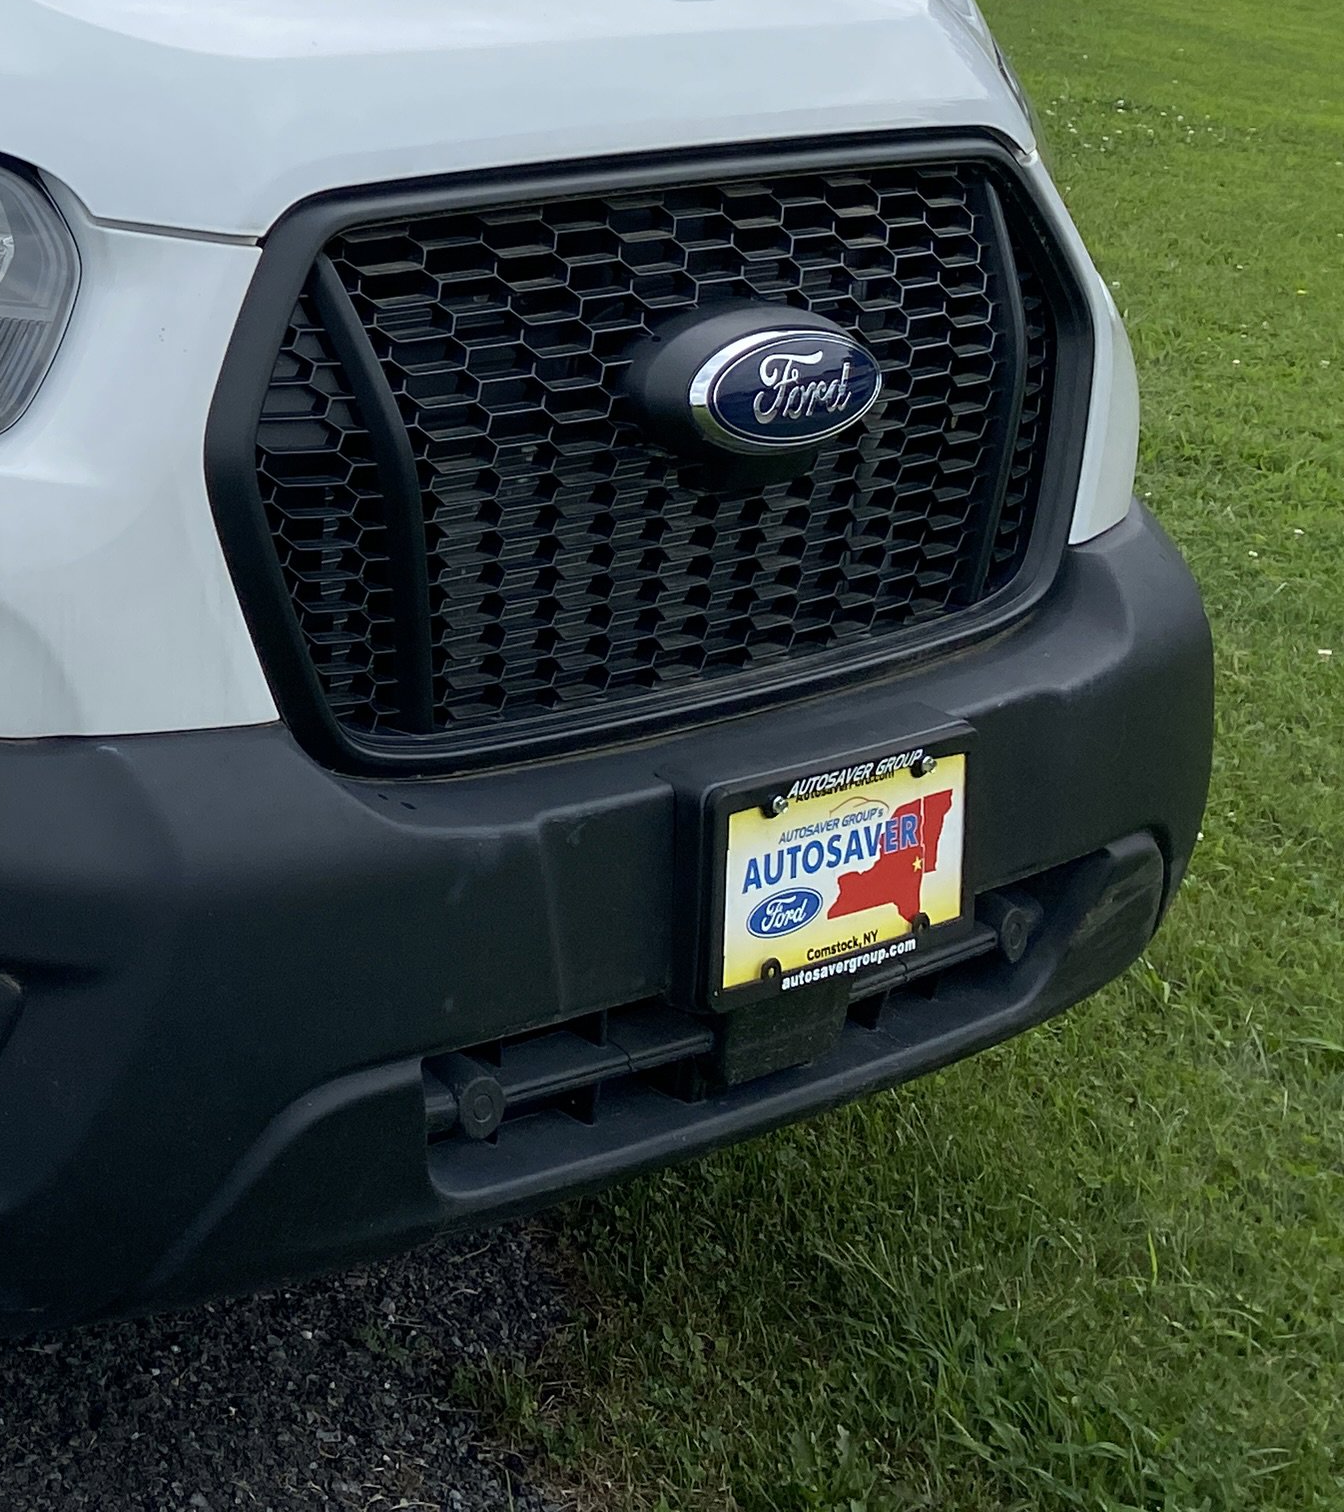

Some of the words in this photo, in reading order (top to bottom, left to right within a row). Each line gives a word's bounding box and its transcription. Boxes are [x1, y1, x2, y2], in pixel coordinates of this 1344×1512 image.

[753, 350, 852, 425] Ford
[787, 762, 874, 799] AUTOSAVER
[876, 749, 924, 776] GROUP
[742, 813, 919, 894] AUTOSAVER
[778, 817, 840, 845] AUTOSAVER
[761, 895, 809, 932] Ford
[781, 938, 916, 990] autosavergroup.com
[806, 935, 863, 962] Comstock,
[863, 929, 879, 946] NY
